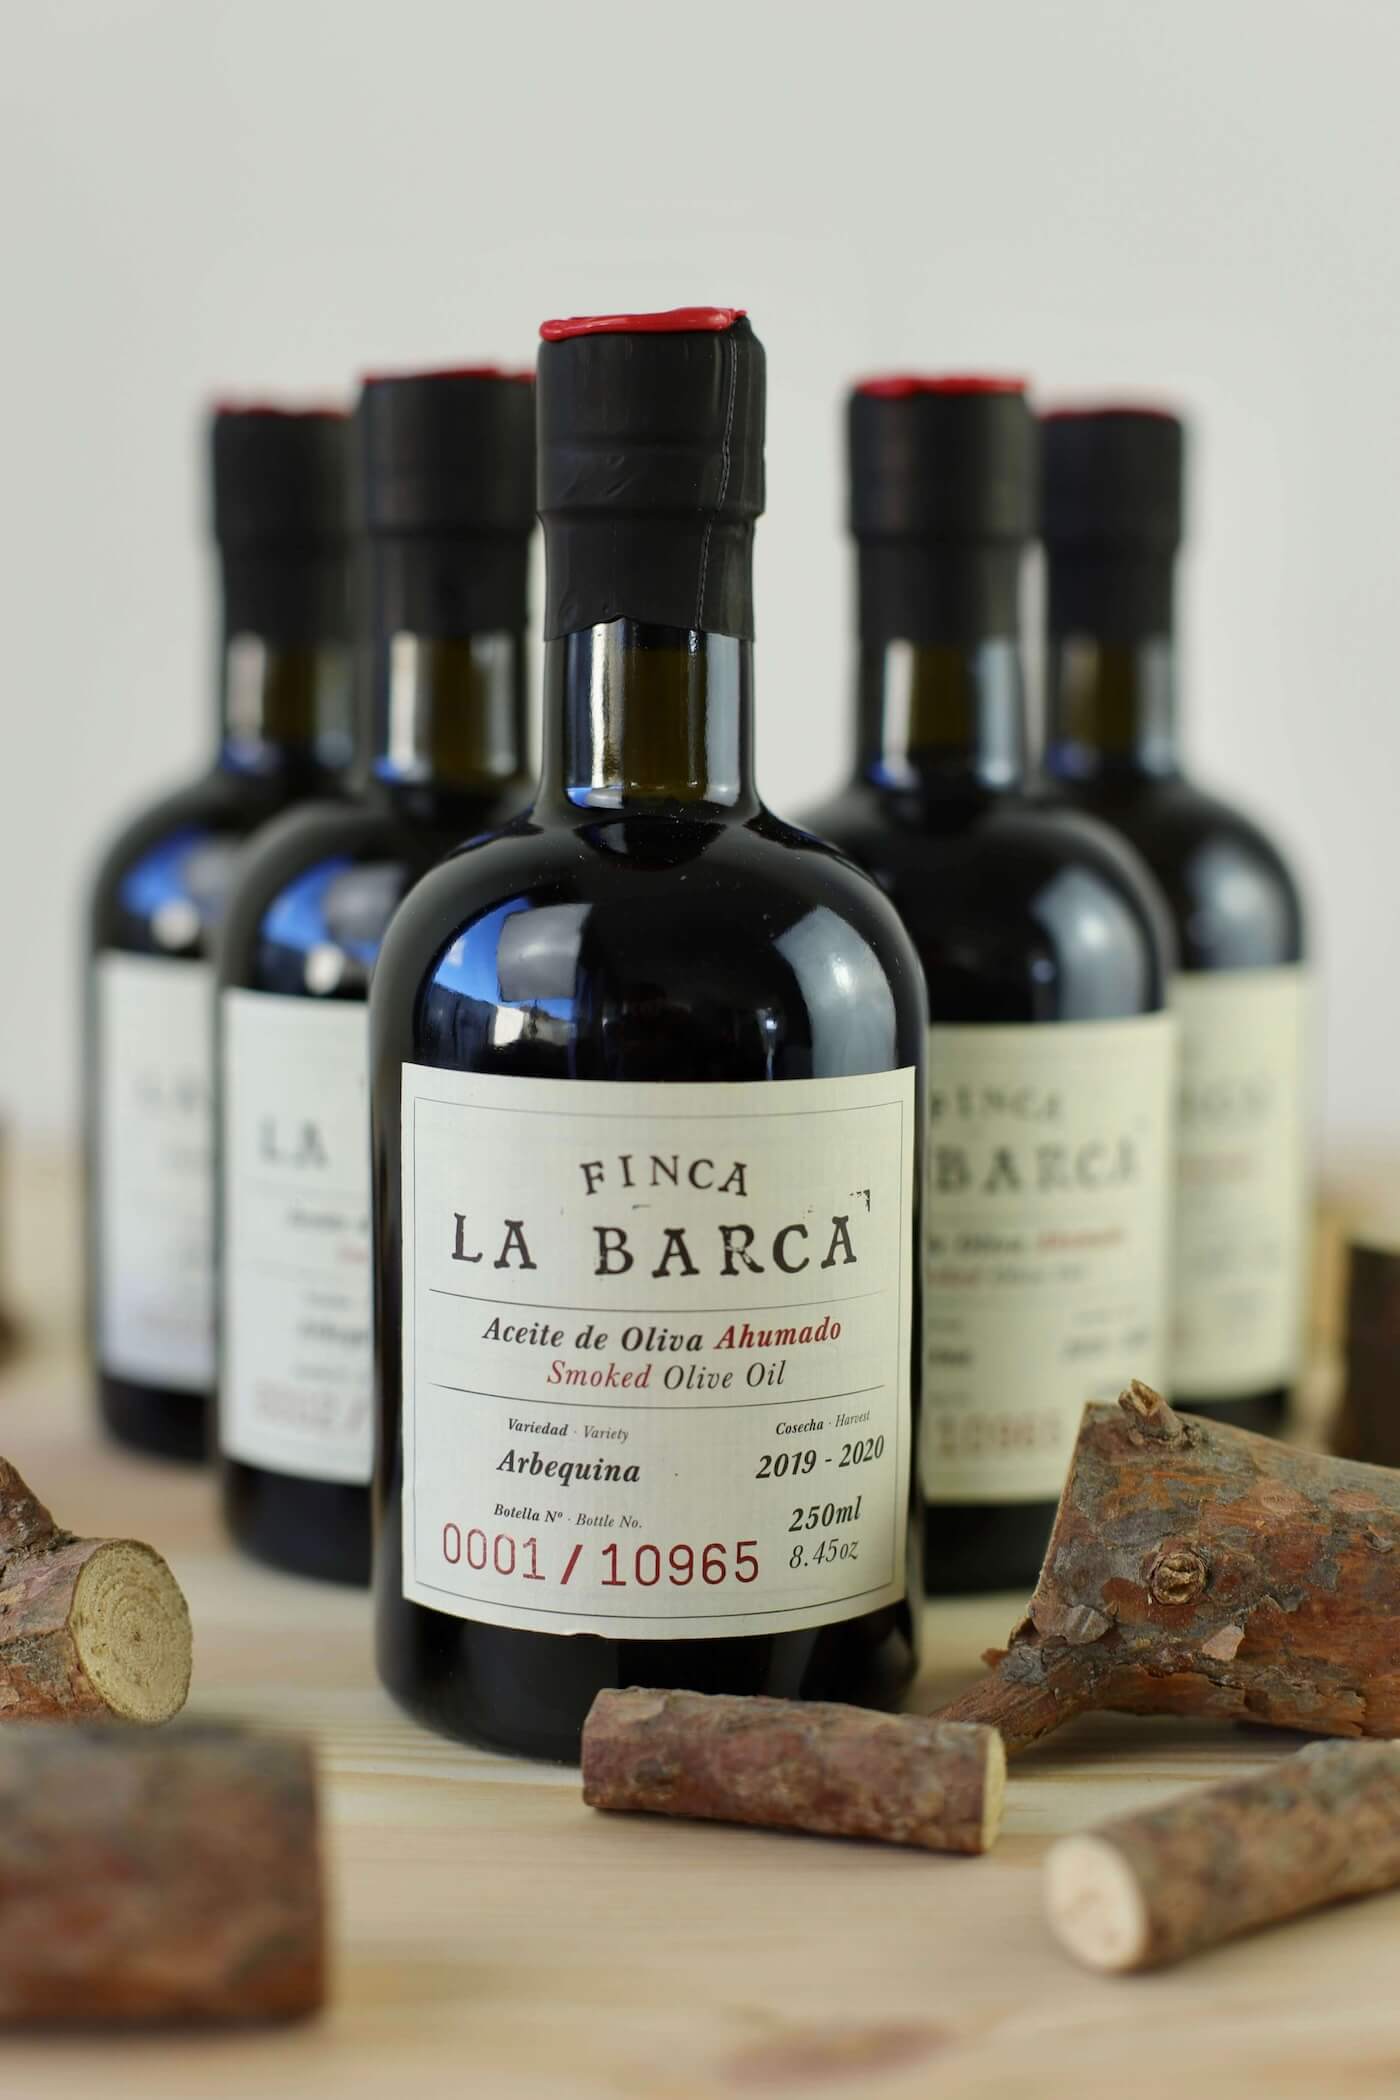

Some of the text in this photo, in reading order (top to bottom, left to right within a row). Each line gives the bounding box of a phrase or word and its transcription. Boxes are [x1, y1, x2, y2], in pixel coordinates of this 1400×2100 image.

[580, 1155, 747, 1197] FINCA
[452, 1212, 537, 1270] LA
[593, 1215, 857, 1278] BARCA
[482, 1316, 841, 1351] Aceite de Oliva Ahumado
[547, 1360, 786, 1389] Smoked Olive Oil
[509, 1418, 628, 1444] Variedad Variety
[776, 1411, 870, 1435] Cosecha Harvest
[496, 1449, 640, 1487] Arbequina
[494, 1504, 539, 1521] Botella
[576, 1513, 614, 1527] Bottle
[619, 1516, 642, 1528] No.
[788, 1496, 861, 1532] 250ml
[789, 1539, 858, 1568] 8.45oz
